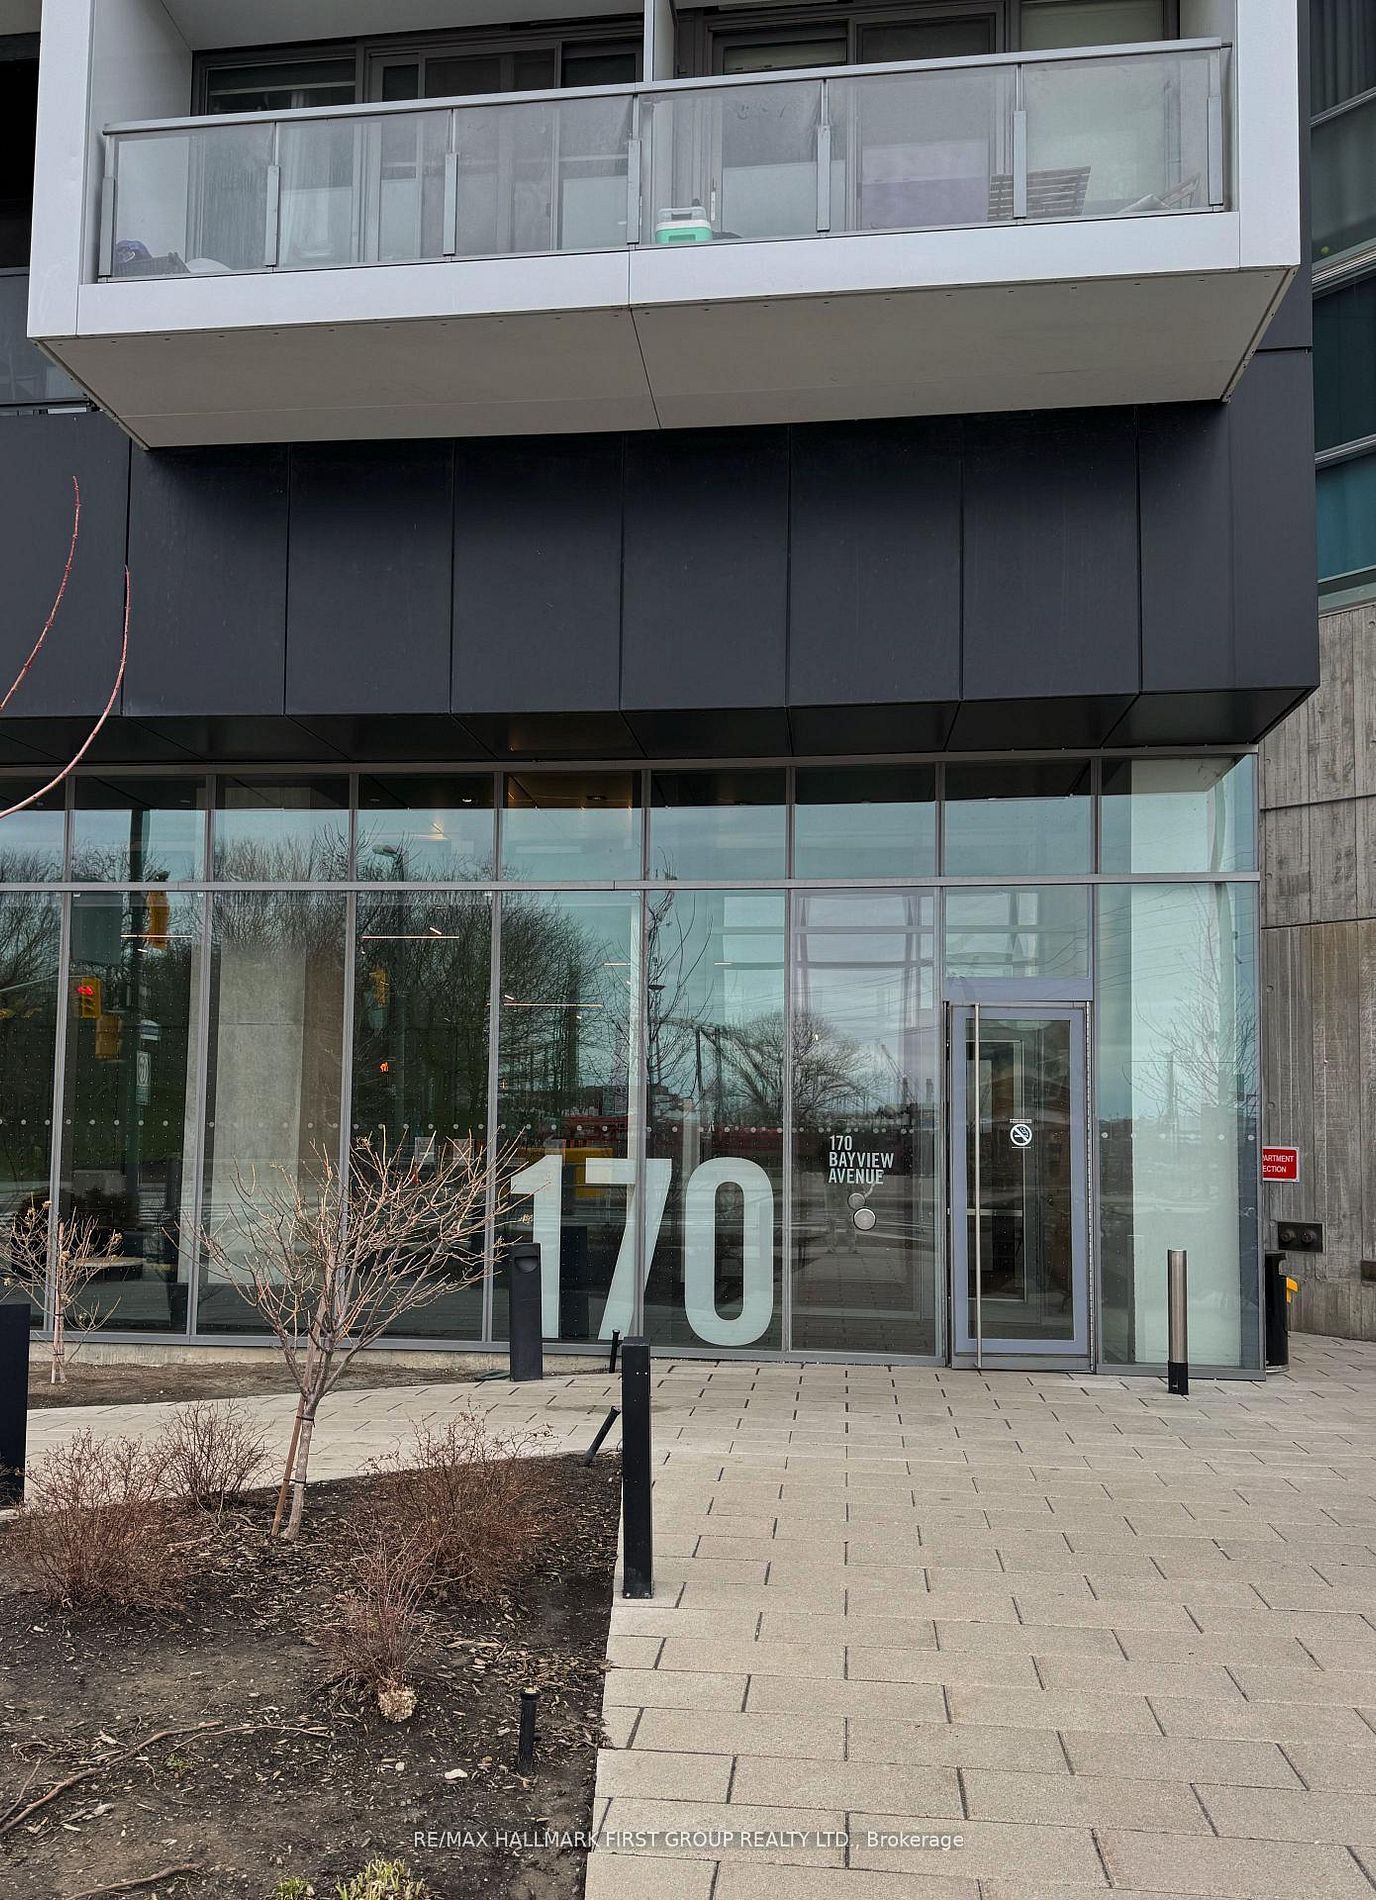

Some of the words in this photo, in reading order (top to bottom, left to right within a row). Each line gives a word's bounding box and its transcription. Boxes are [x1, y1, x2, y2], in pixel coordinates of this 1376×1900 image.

[829, 1135, 853, 1151] 170
[829, 1151, 895, 1168] BAYVIEW
[1262, 1154, 1295, 1163] ARTMENT
[828, 1168, 885, 1184] AVENUE
[511, 1154, 774, 1346] 170
